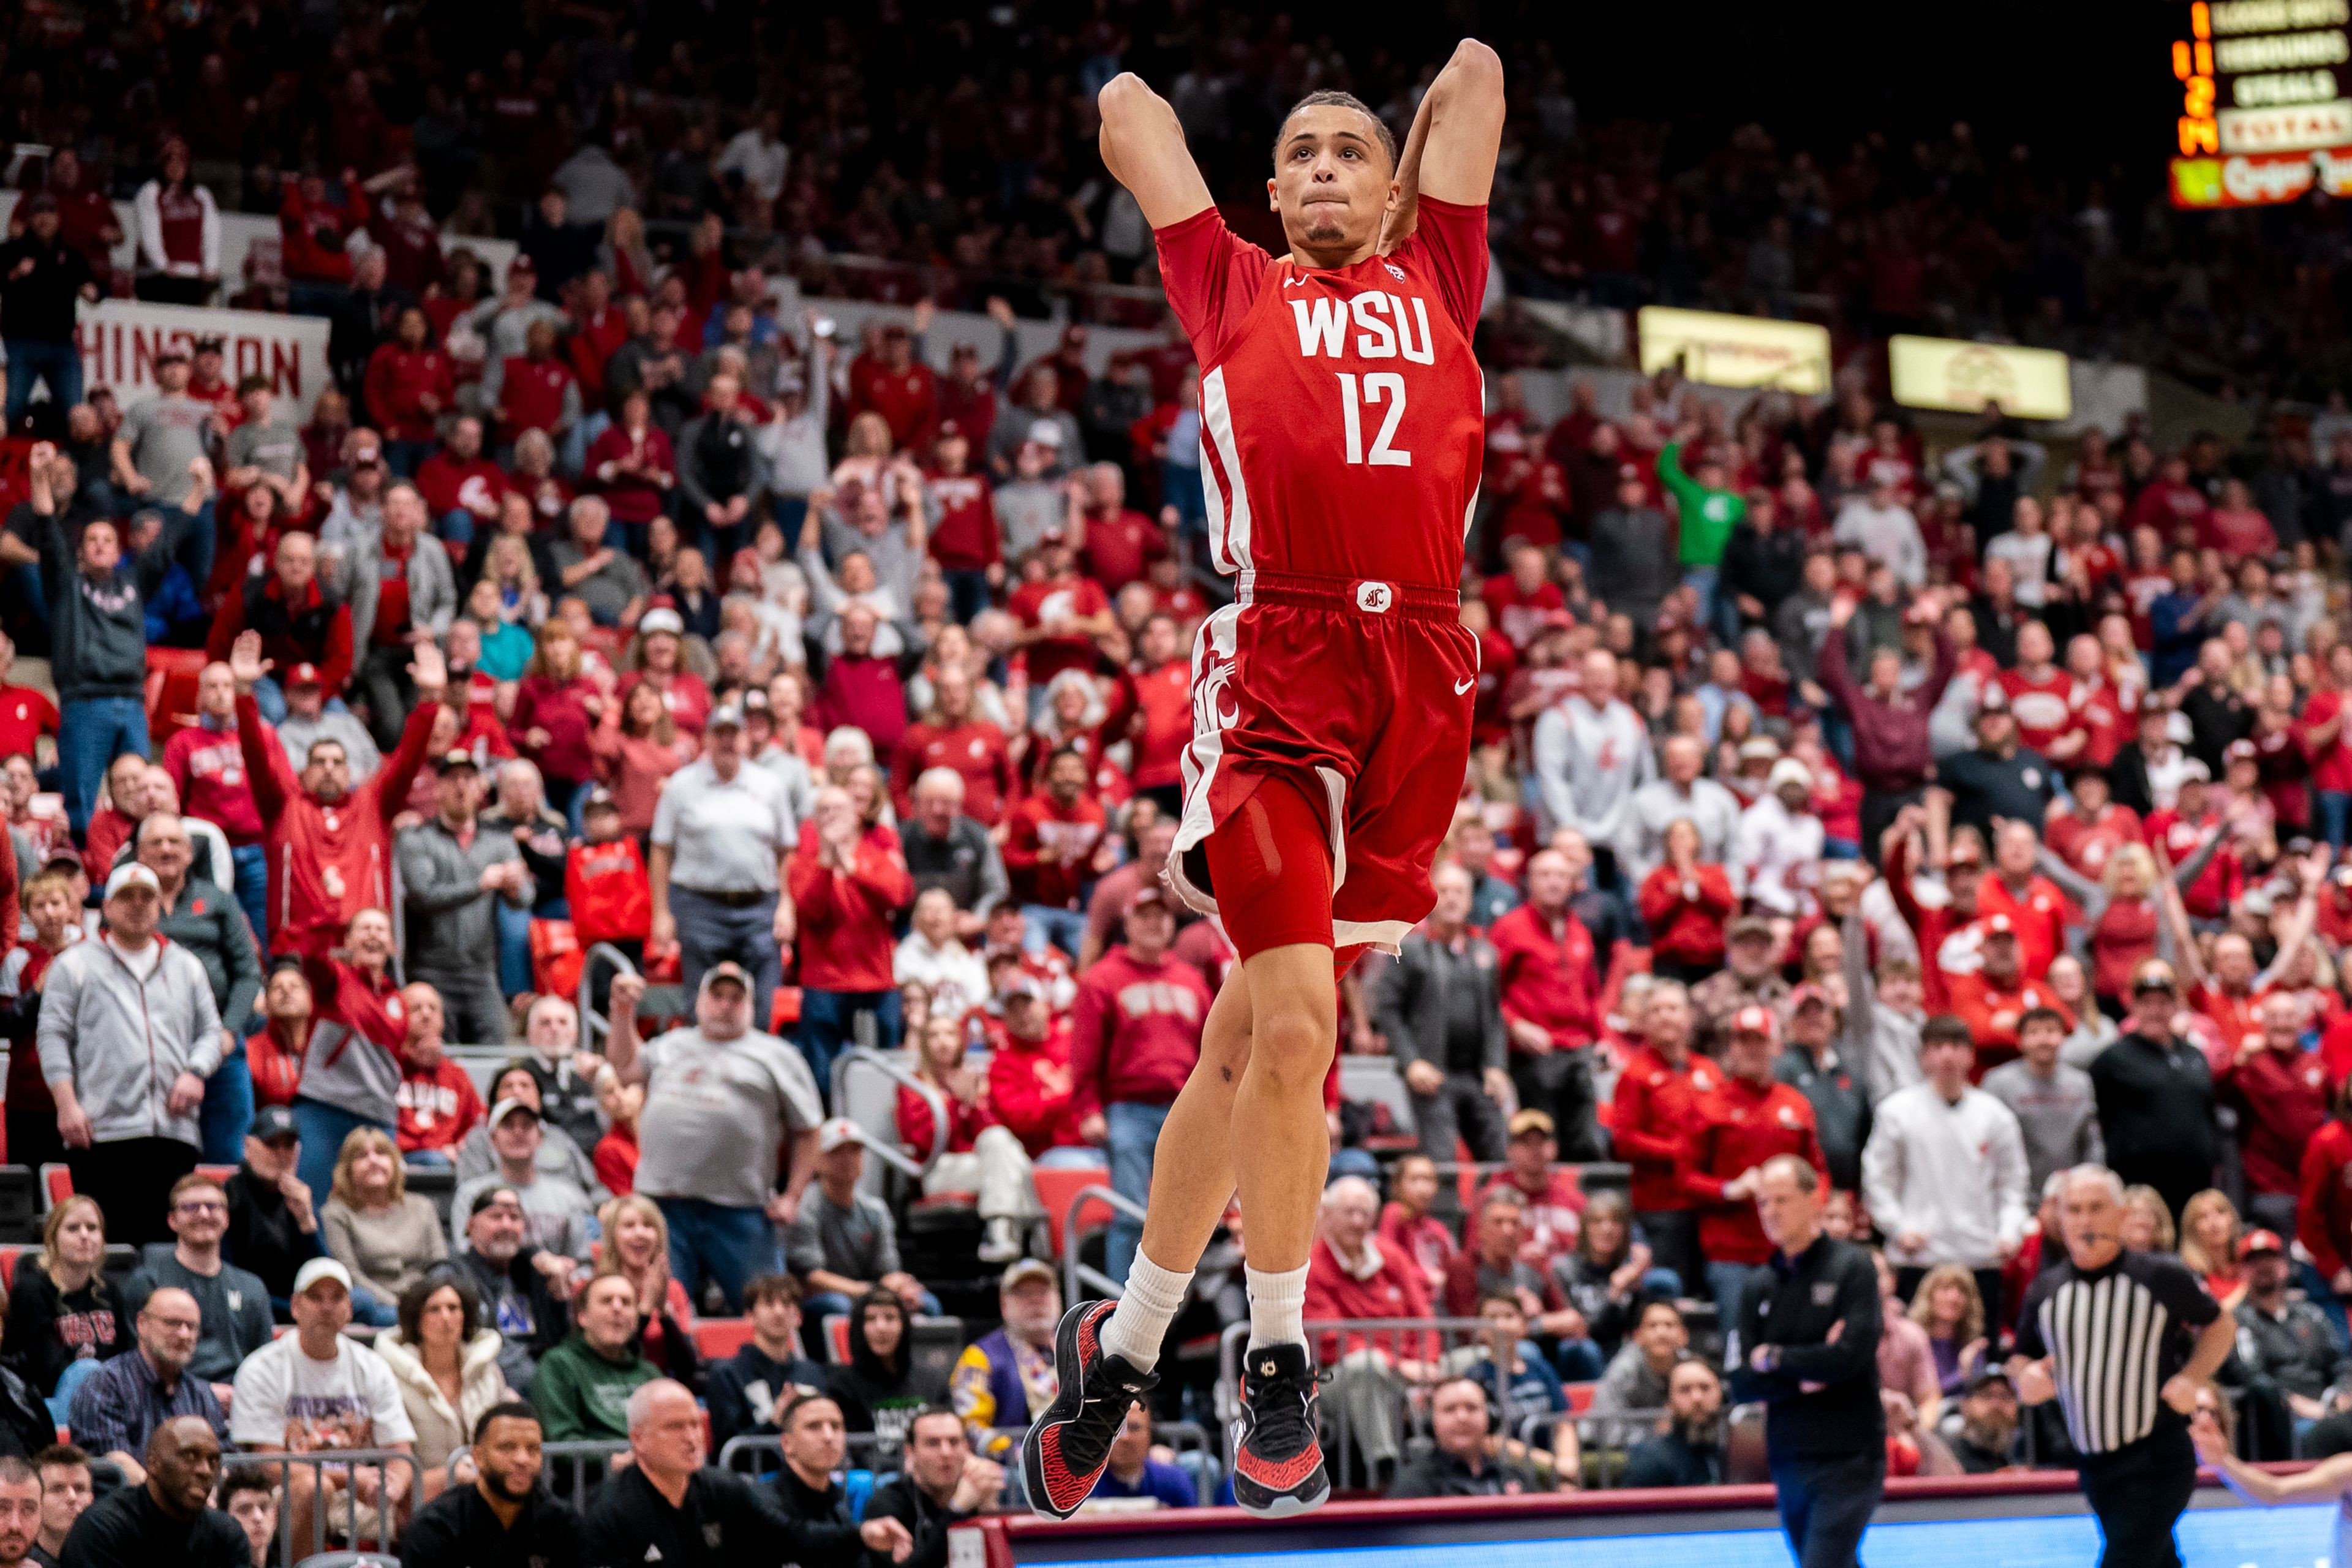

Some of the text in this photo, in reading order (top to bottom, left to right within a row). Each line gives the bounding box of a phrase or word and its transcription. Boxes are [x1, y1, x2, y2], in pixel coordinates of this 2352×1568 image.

[75, 318, 301, 399] HINON
[1287, 290, 1434, 366] WSU
[1335, 372, 1411, 467] 12
